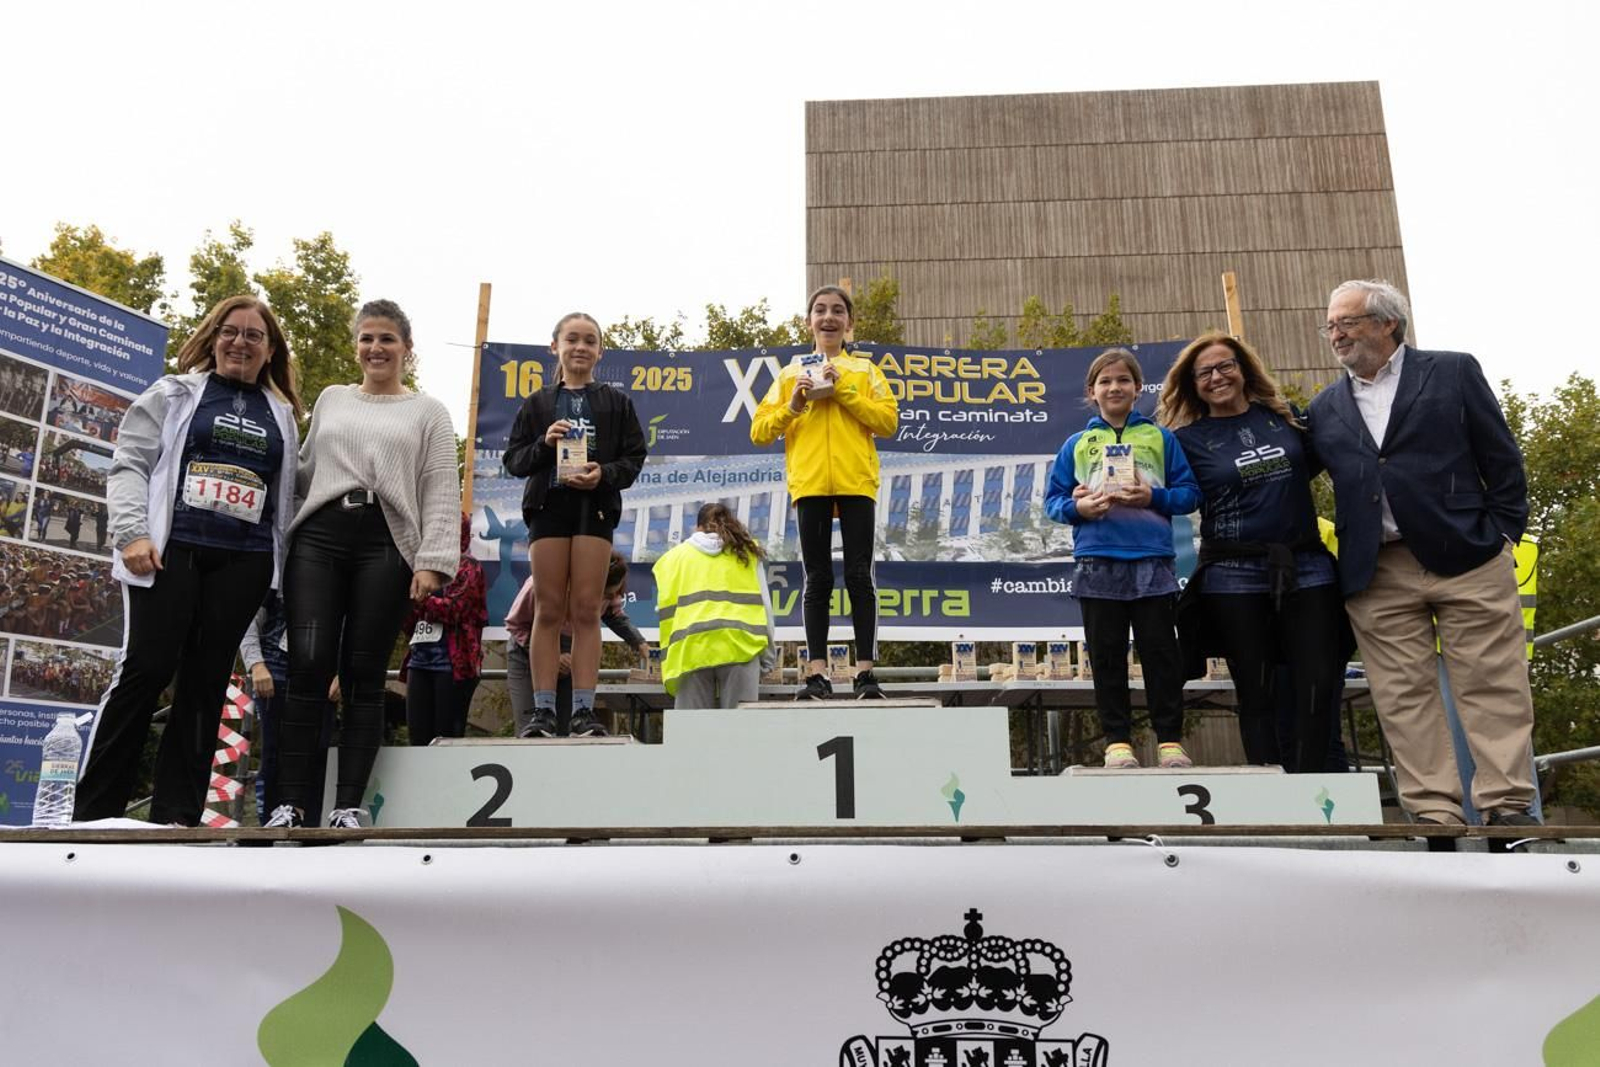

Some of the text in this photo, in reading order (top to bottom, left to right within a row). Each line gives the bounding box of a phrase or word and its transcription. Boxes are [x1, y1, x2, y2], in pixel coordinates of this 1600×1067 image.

[27, 287, 98, 320] Aniversario
[98, 314, 112, 327] de
[113, 319, 125, 332] la
[3, 305, 16, 319] la
[17, 311, 41, 328] Paz
[41, 321, 50, 333] y
[50, 323, 63, 335] la
[63, 328, 131, 361] Integración
[9, 294, 59, 319] Popular
[58, 313, 68, 325] y
[68, 316, 97, 335] Gran
[98, 328, 154, 356] Caminata
[55, 348, 92, 367] deporte,
[93, 361, 112, 374] vida
[112, 368, 119, 378] y
[119, 371, 149, 386] valores
[500, 360, 544, 399] 16
[631, 366, 693, 392] 2025
[852, 350, 1041, 380] ARRERA
[213, 412, 267, 437] 25
[938, 408, 1048, 422] caminata
[896, 423, 996, 452] Integración
[1105, 444, 1132, 457] XXV
[1234, 444, 1286, 467] 25
[667, 470, 688, 483] de
[196, 479, 256, 509] 1184
[816, 736, 856, 819] 1
[466, 763, 513, 827] 2
[1176, 783, 1216, 825] 3
